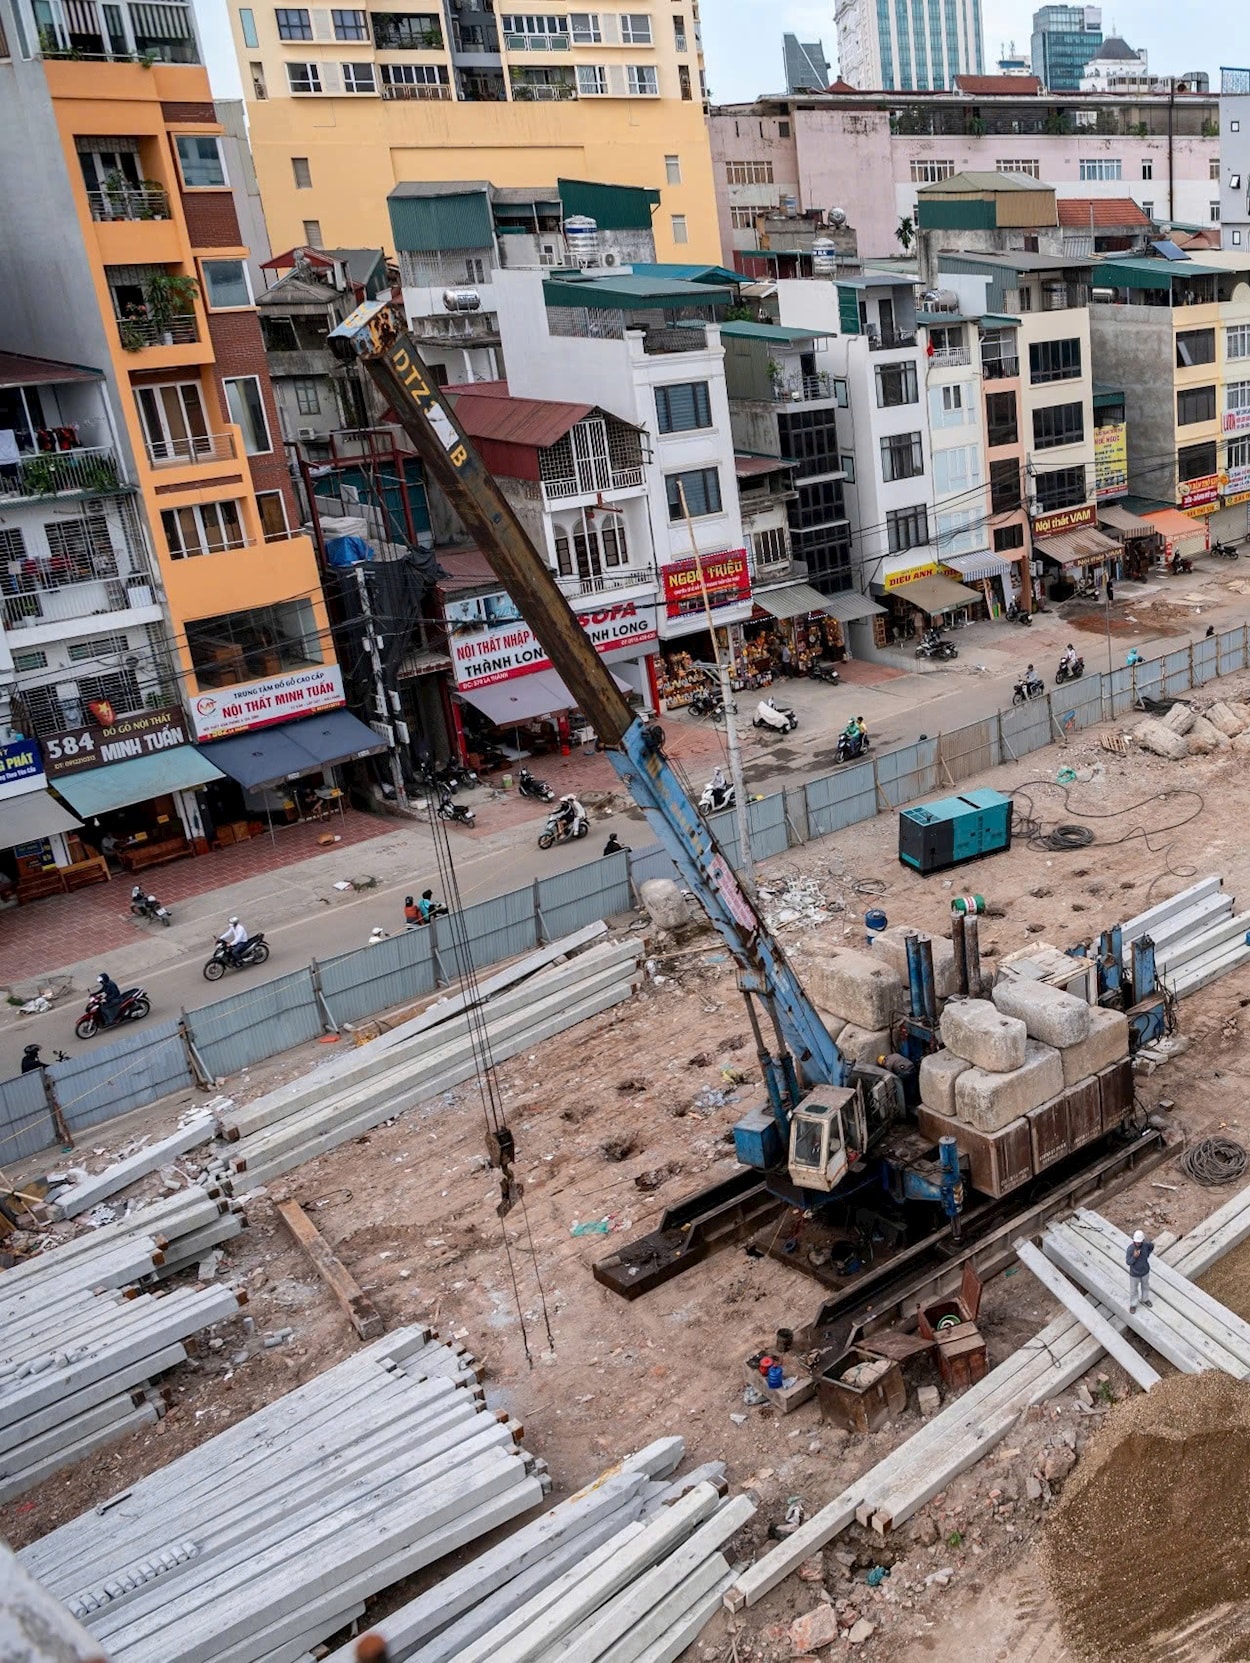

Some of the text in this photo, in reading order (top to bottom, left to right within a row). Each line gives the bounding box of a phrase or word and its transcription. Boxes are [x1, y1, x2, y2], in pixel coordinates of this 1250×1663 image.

[1070, 509, 1091, 523] VAM
[913, 569, 933, 580] ANH
[577, 602, 637, 628] SOFA
[613, 620, 648, 637] LONG
[456, 643, 476, 661] NỘI
[476, 634, 501, 655] THẤT
[502, 630, 529, 648] NHẬP
[465, 645, 546, 677] THÀNH LON
[233, 688, 257, 699] TRUNG
[259, 683, 273, 693] TÂM
[296, 675, 310, 684] CAO
[311, 671, 324, 681] CẤP
[222, 679, 334, 718] NỘI THẤT MINH TUẤN
[133, 718, 149, 731] NỘI
[150, 711, 173, 727] THẤT
[46, 732, 95, 759] 584
[100, 724, 184, 763] MINH TUẤN
[6, 752, 34, 770] PHÁT
